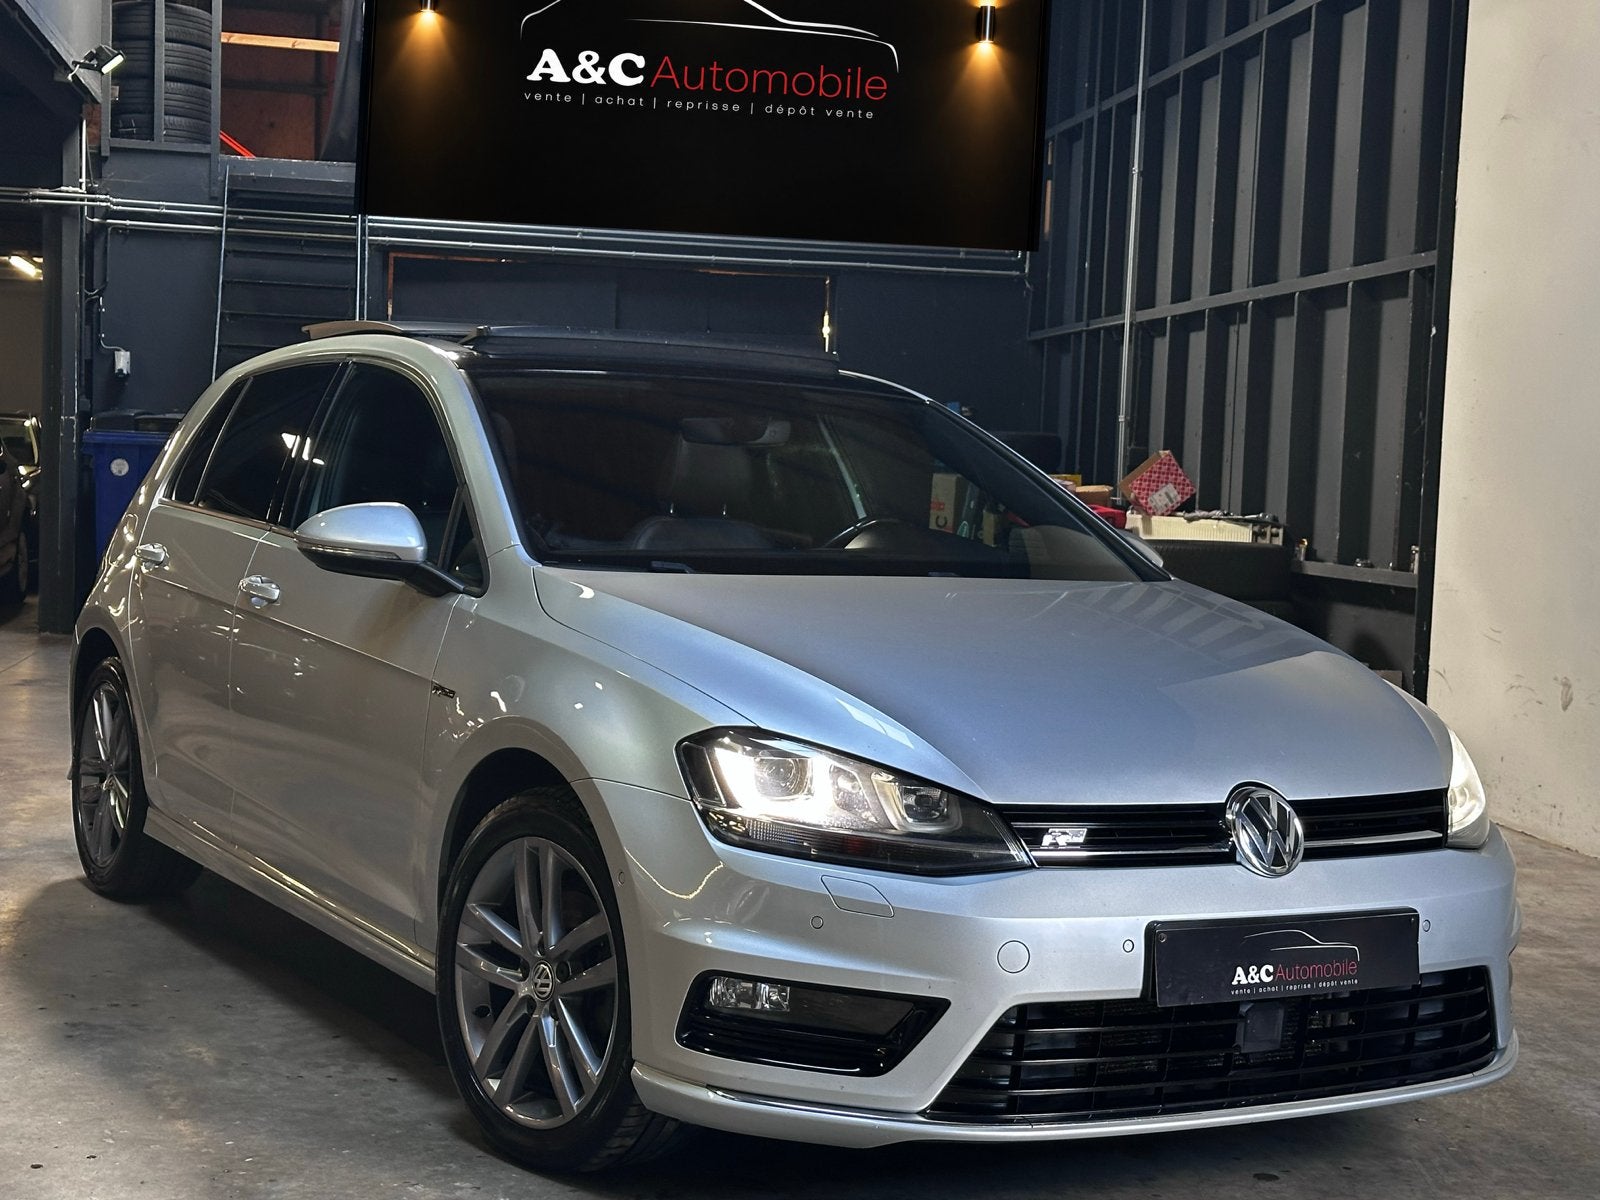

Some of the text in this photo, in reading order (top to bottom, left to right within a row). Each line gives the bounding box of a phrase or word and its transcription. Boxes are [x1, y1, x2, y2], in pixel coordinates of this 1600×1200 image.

[526, 48, 888, 101] A&C Automobile
[524, 92, 874, 120] vente achat reprisse dépôt vente
[1231, 959, 1358, 986] A&C Automobile
[1230, 988, 1251, 996] vente
[1258, 984, 1279, 993] achat
